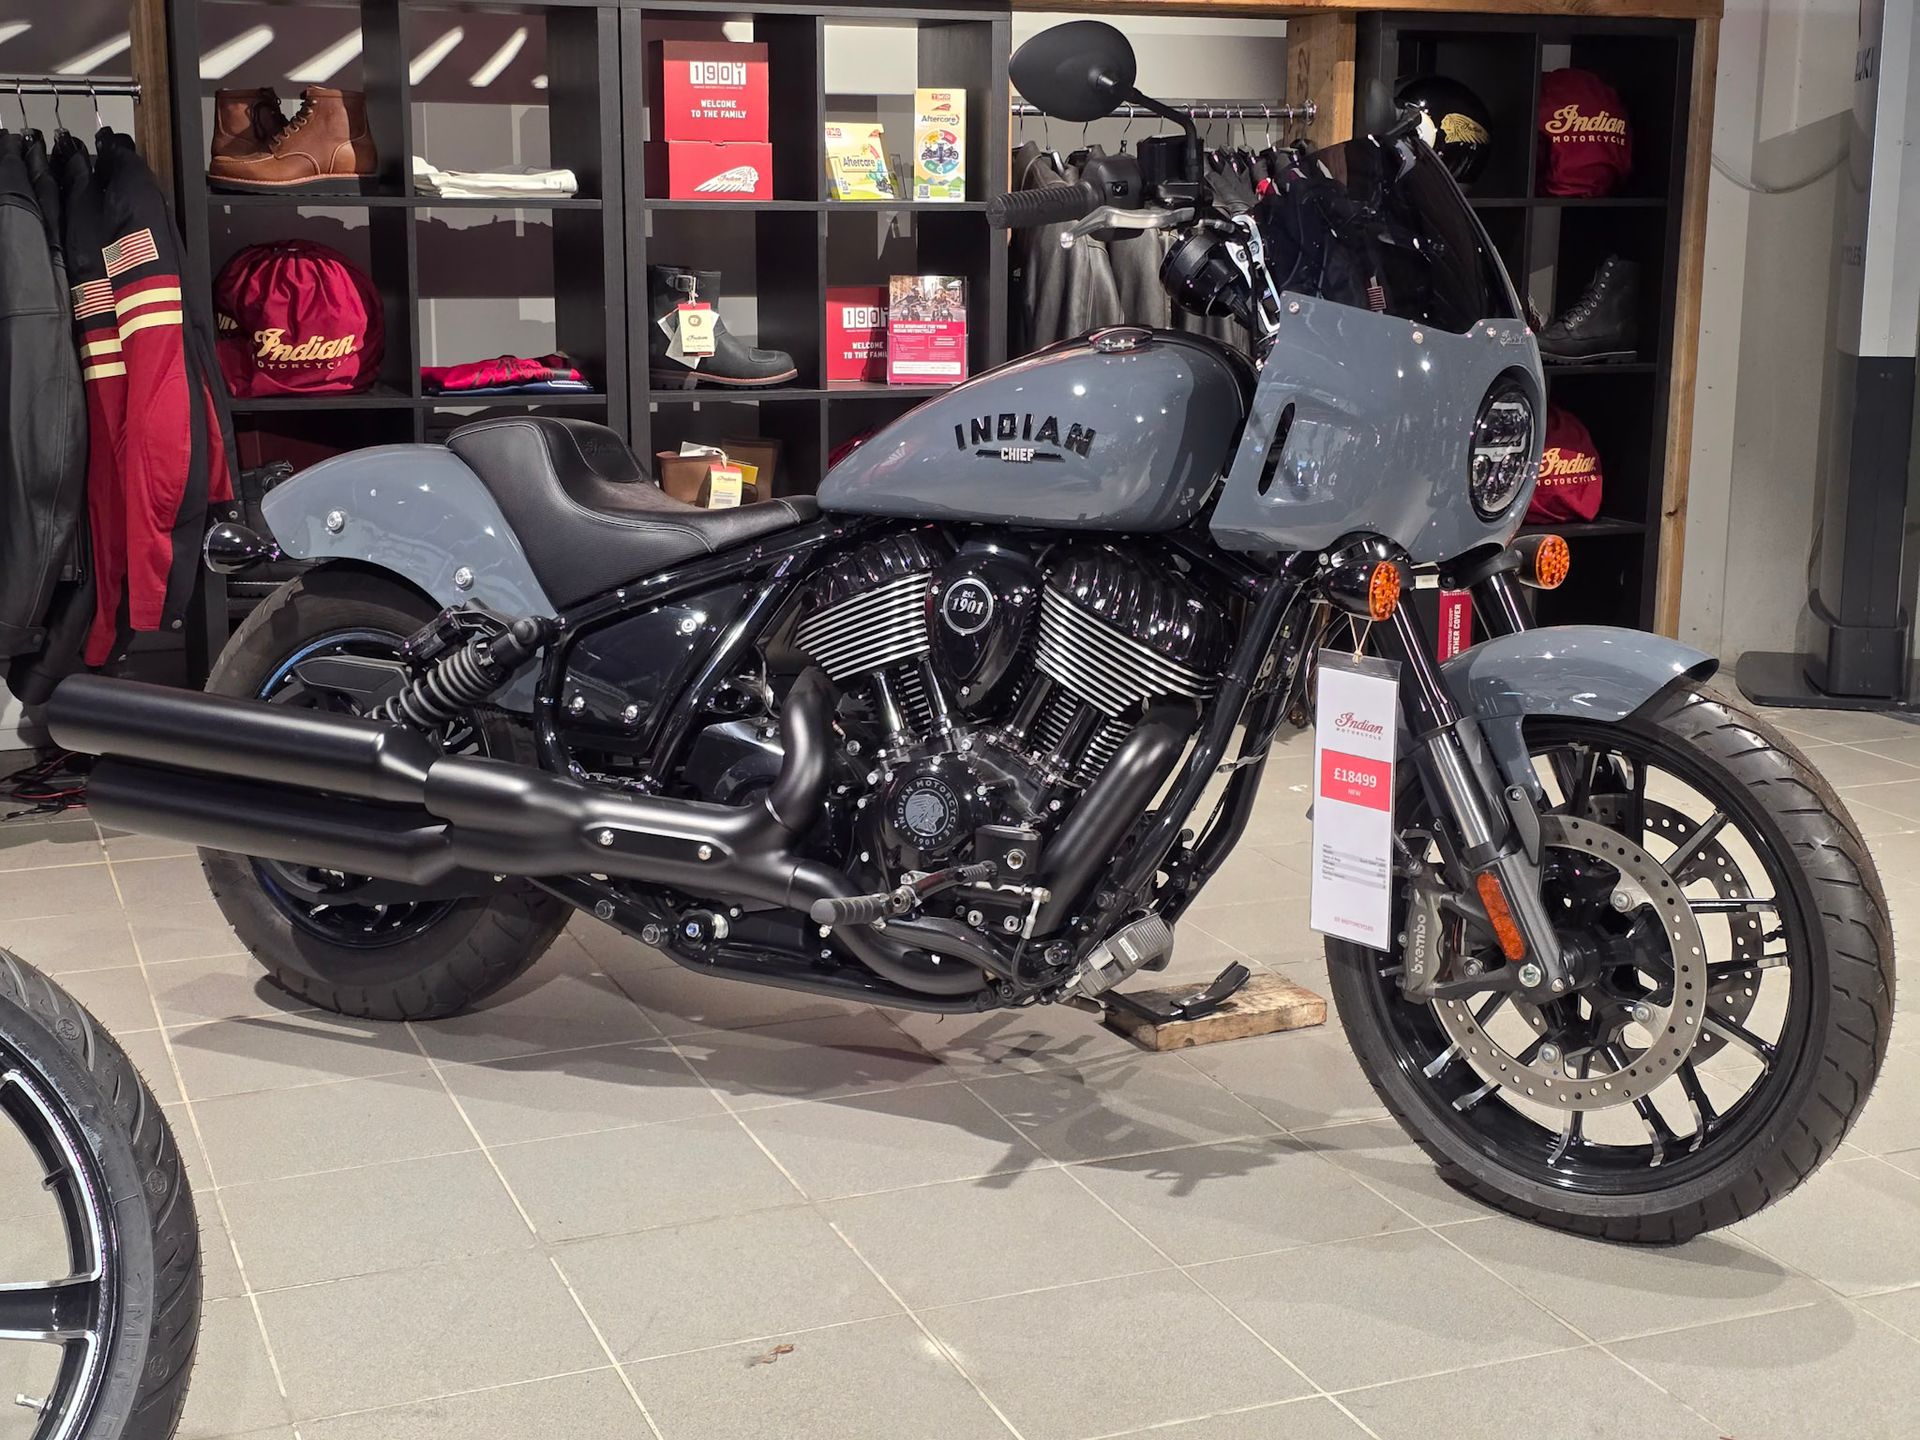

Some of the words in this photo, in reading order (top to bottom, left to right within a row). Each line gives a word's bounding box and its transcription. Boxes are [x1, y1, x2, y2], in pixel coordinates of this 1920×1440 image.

[692, 61, 745, 85] 1901
[701, 99, 737, 108] WELCOME
[691, 109, 701, 118] TO
[703, 110, 718, 118] THE
[721, 110, 747, 119] FAMILY
[922, 115, 956, 123] Aftercare
[1545, 104, 1626, 135] Indian
[1552, 134, 1626, 146] MOTORCYCLE
[843, 156, 876, 168] Aftercare
[254, 328, 357, 362] Indian
[852, 342, 884, 350] WELCOME
[843, 351, 853, 359] TO
[854, 351, 868, 359] THE
[253, 357, 347, 370] OTORCYCL
[955, 413, 1097, 459] INDIAN
[1000, 447, 1035, 462] CHIEF
[951, 597, 984, 615] 1901
[1453, 603, 1462, 629] COVER
[1452, 630, 1460, 656] ATHER
[1335, 712, 1383, 735] Indian
[1336, 727, 1382, 741] MOTORCYCLE
[1333, 767, 1377, 788] £18499
[1347, 788, 1361, 797] NEW
[898, 786, 914, 829] INDIAN
[916, 780, 957, 837] MOTORCYCLE
[1410, 914, 1426, 975] brembo
